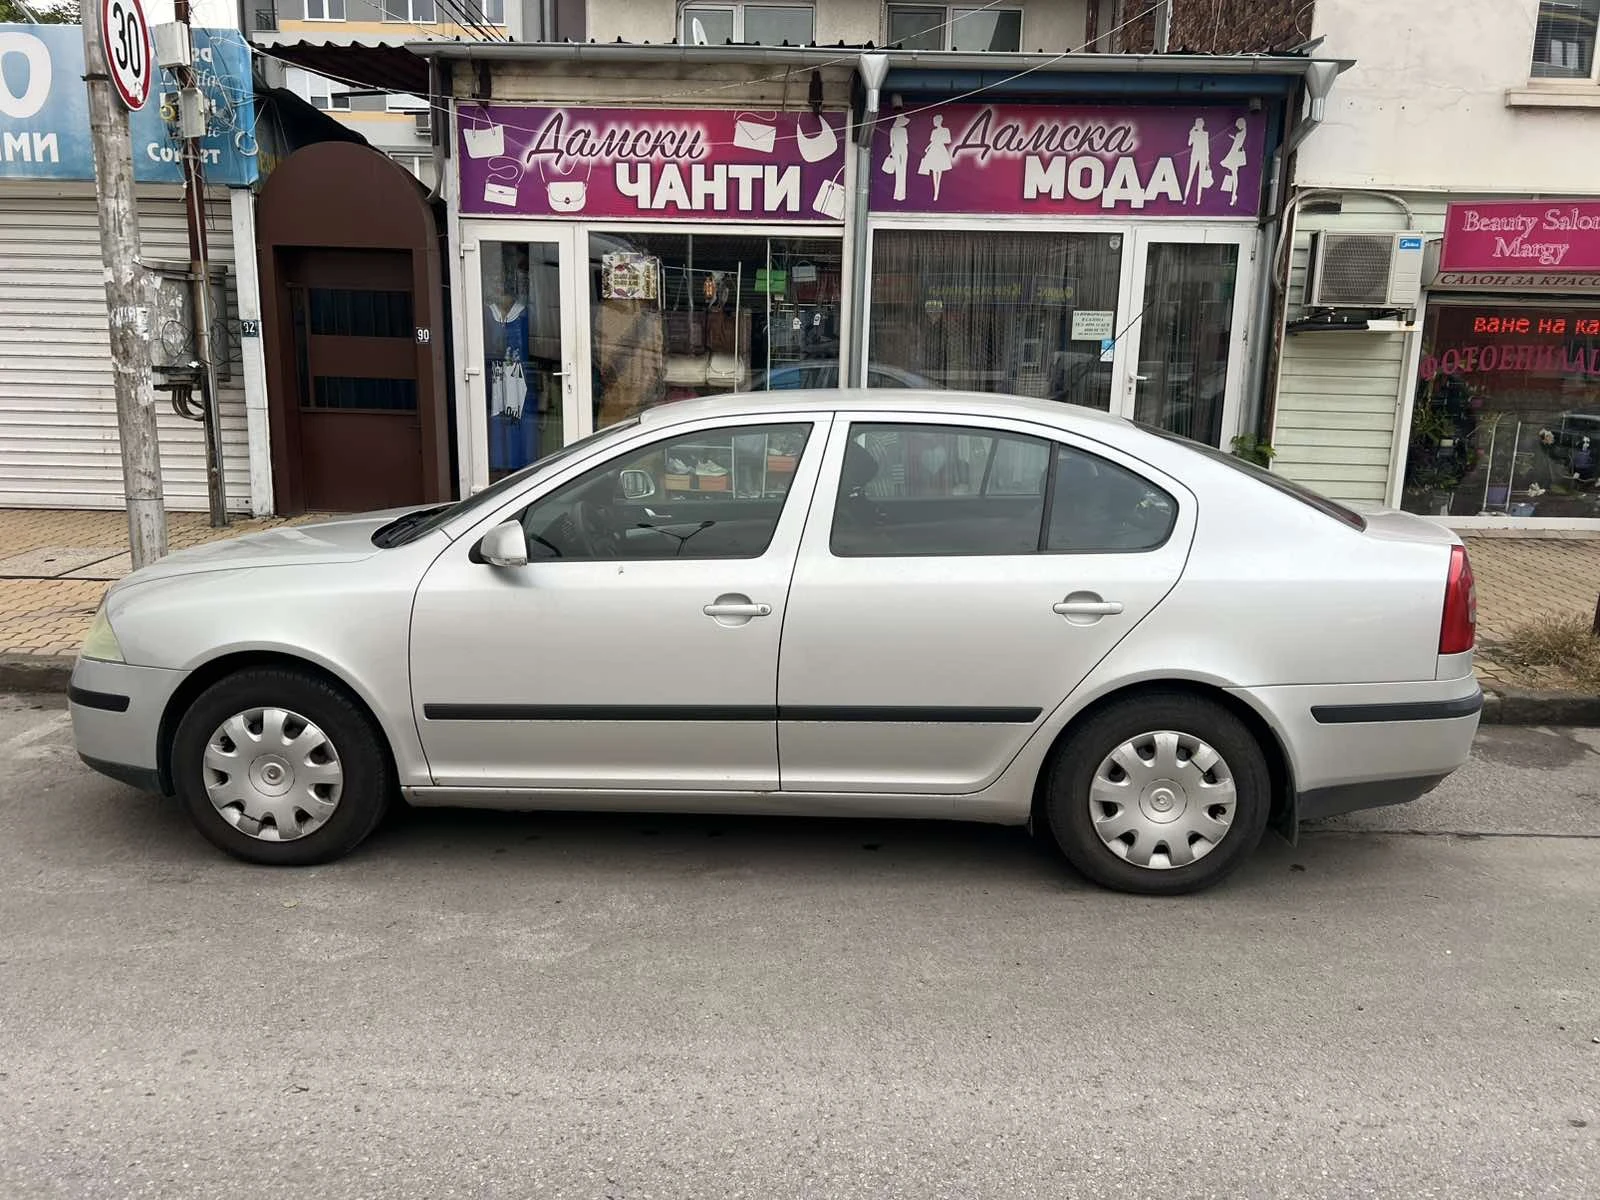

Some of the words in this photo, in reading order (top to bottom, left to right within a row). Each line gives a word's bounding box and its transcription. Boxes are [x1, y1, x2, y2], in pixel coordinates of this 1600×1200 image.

[113, 2, 141, 78] 30
[0, 132, 59, 163] МИ
[526, 111, 705, 167] Дамски
[951, 108, 1136, 161] Дамска
[615, 162, 800, 212] ЧАНТИ
[1023, 156, 1183, 209] МОДА
[1463, 210, 1538, 239] Beauty
[1492, 236, 1570, 265] Margy
[1440, 274, 1510, 286] САЛОН
[1511, 275, 1535, 287] ЗА
[416, 328, 430, 342] 90
[1473, 316, 1531, 334] ване
[1538, 317, 1566, 335] на
